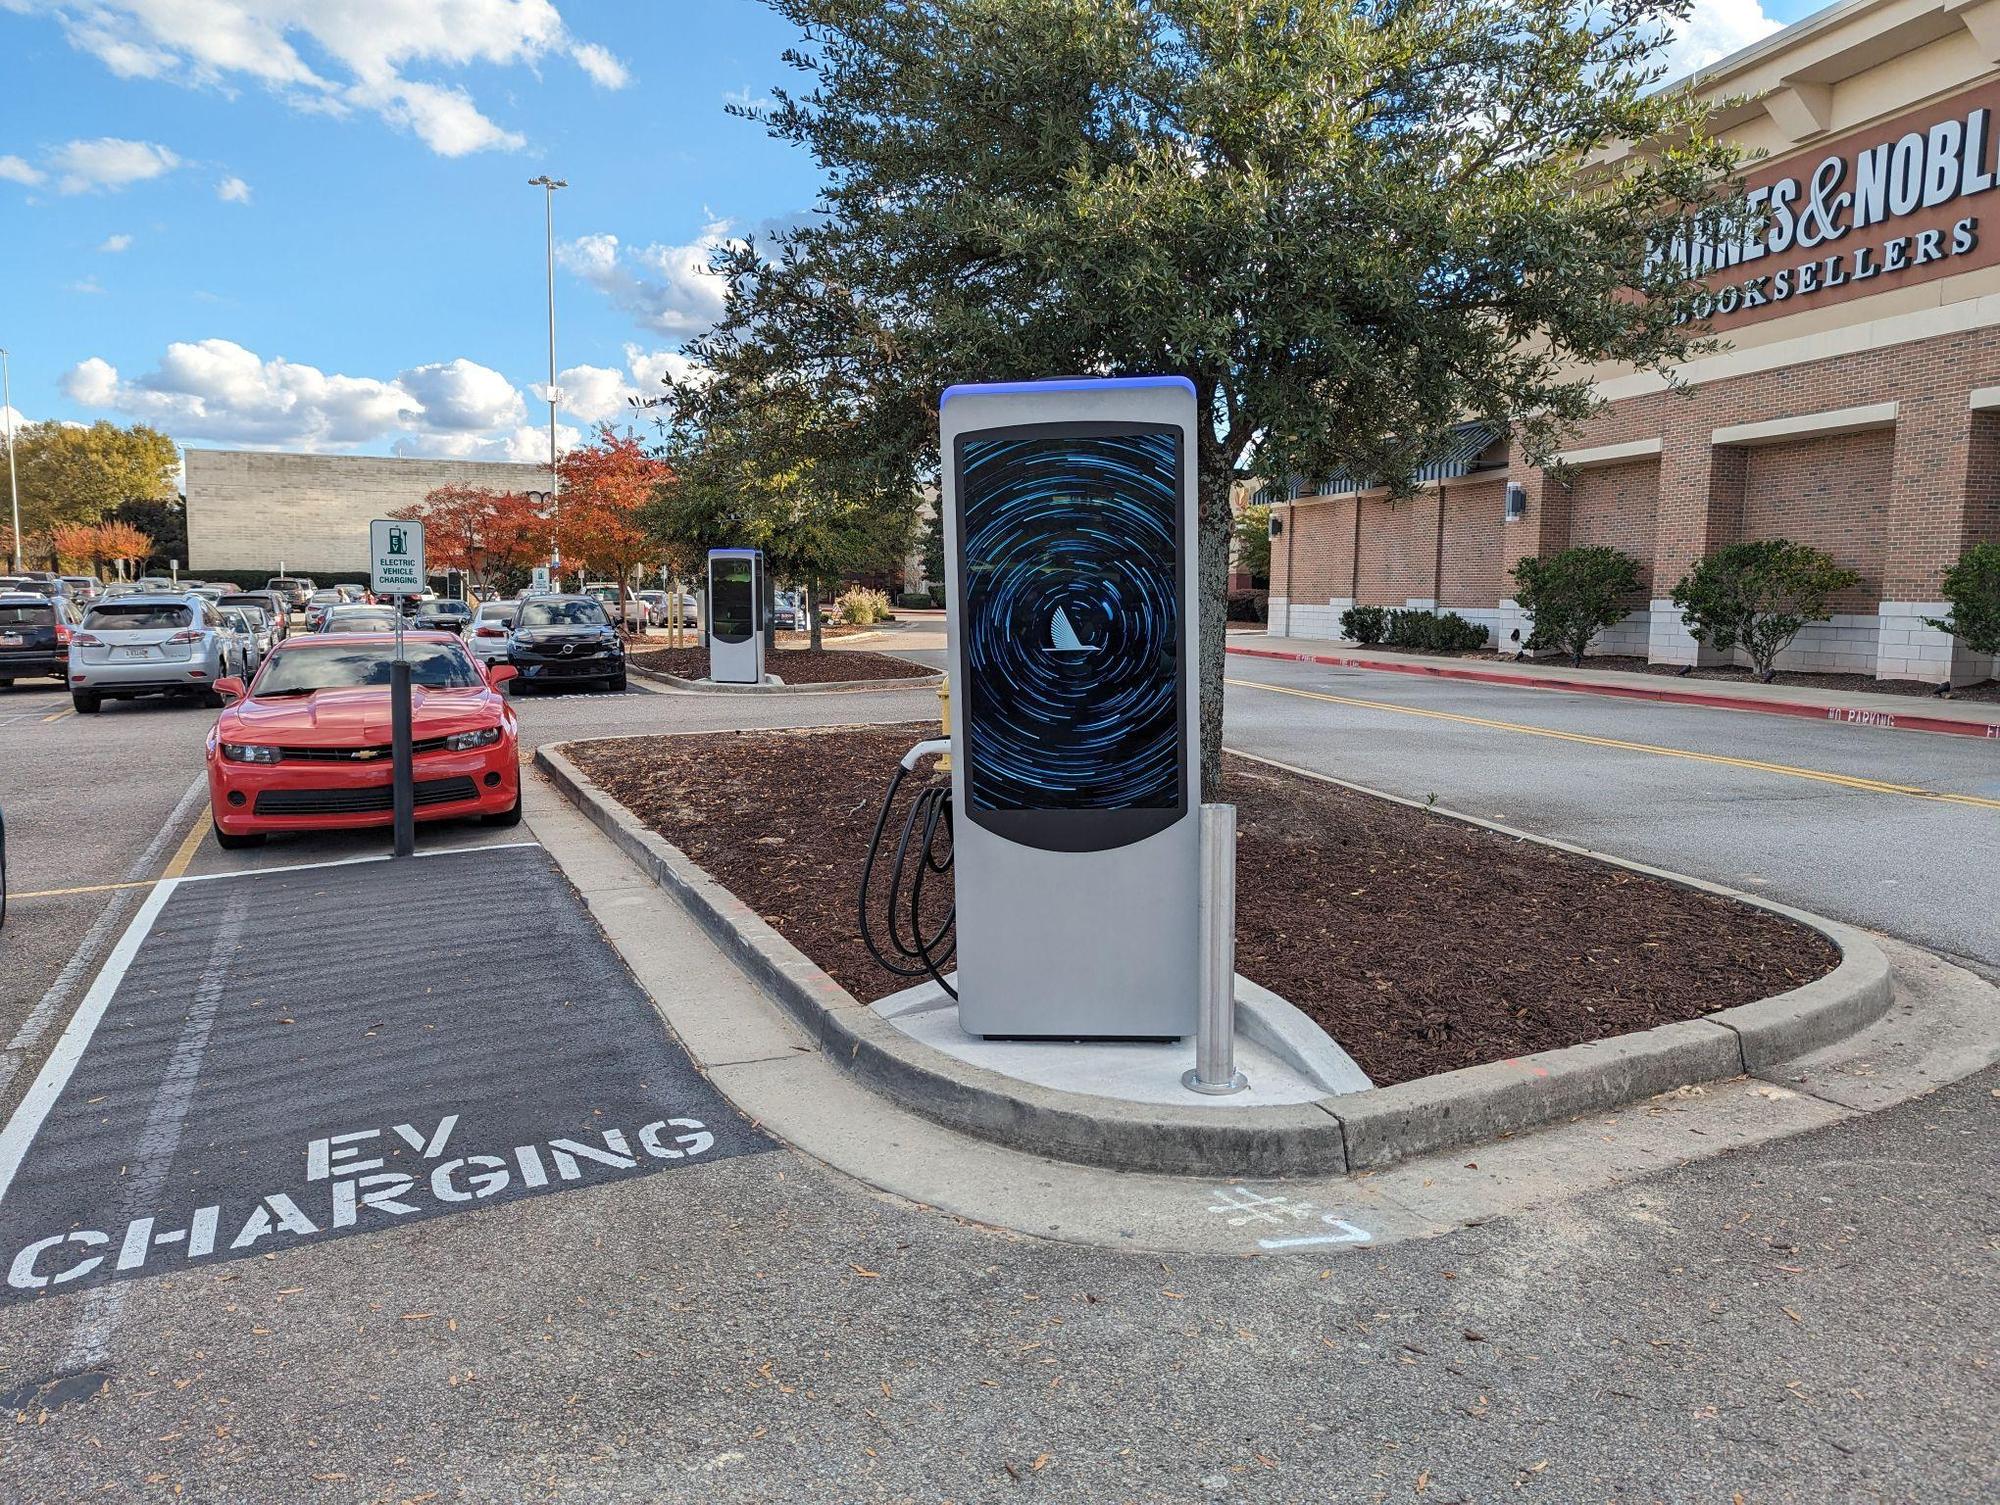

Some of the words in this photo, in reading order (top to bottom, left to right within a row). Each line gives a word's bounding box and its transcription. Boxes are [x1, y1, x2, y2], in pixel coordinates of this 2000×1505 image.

[1853, 108, 2000, 229] NOBL
[380, 558, 416, 567] ELECTRIC
[382, 567, 414, 575] VEHICLE
[379, 576, 418, 584] CHARGING
[1827, 707, 1841, 721] NO
[1847, 708, 1895, 727] PARKING
[306, 1114, 460, 1182] EV
[7, 1118, 716, 1289] CHARGING
